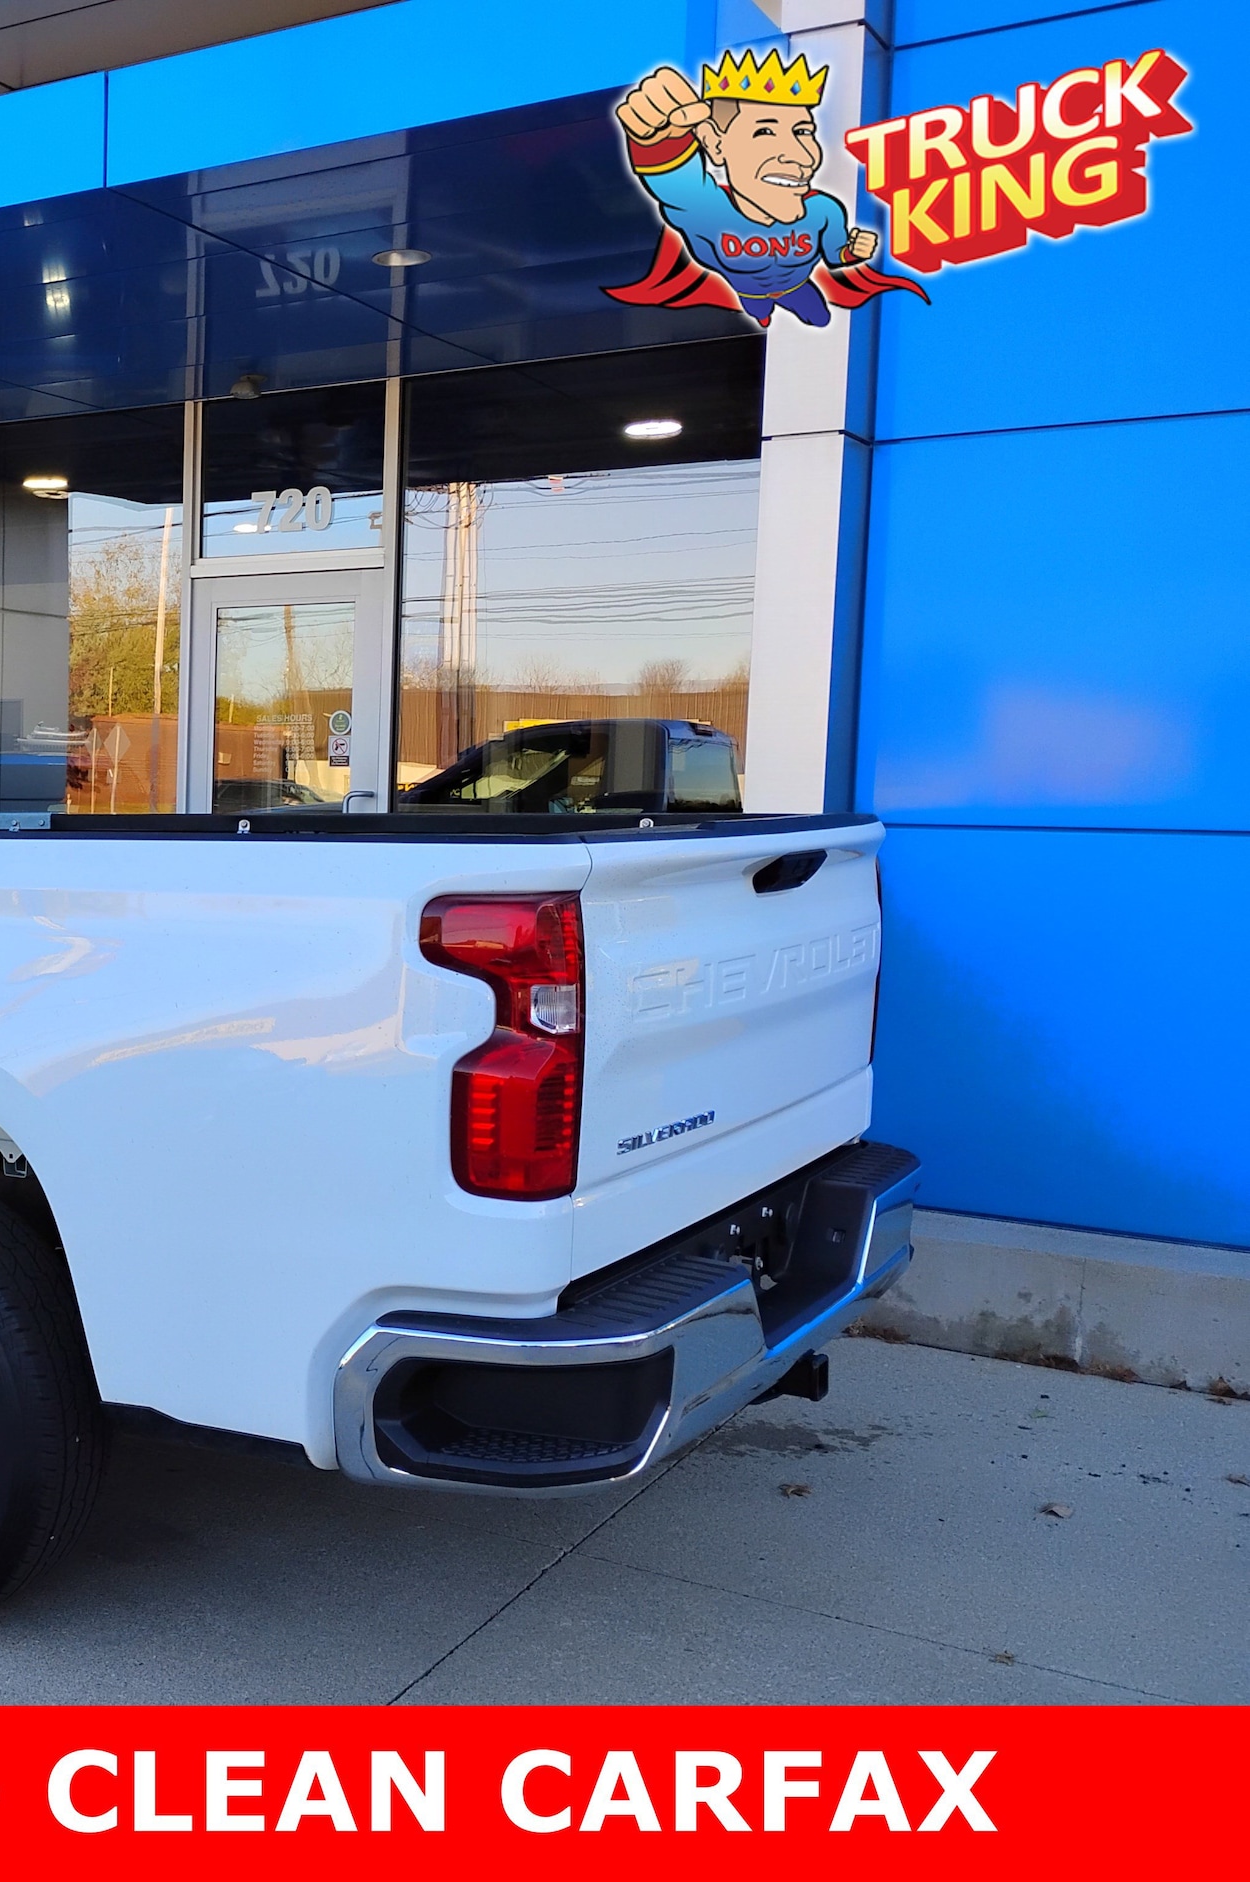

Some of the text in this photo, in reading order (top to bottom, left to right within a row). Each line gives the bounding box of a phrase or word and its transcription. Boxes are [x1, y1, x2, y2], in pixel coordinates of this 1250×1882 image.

[251, 486, 335, 535] 720
[256, 713, 313, 723] SALES HOURS
[629, 920, 881, 1023] CHEVROLET
[616, 1109, 715, 1155] SILVERADO
